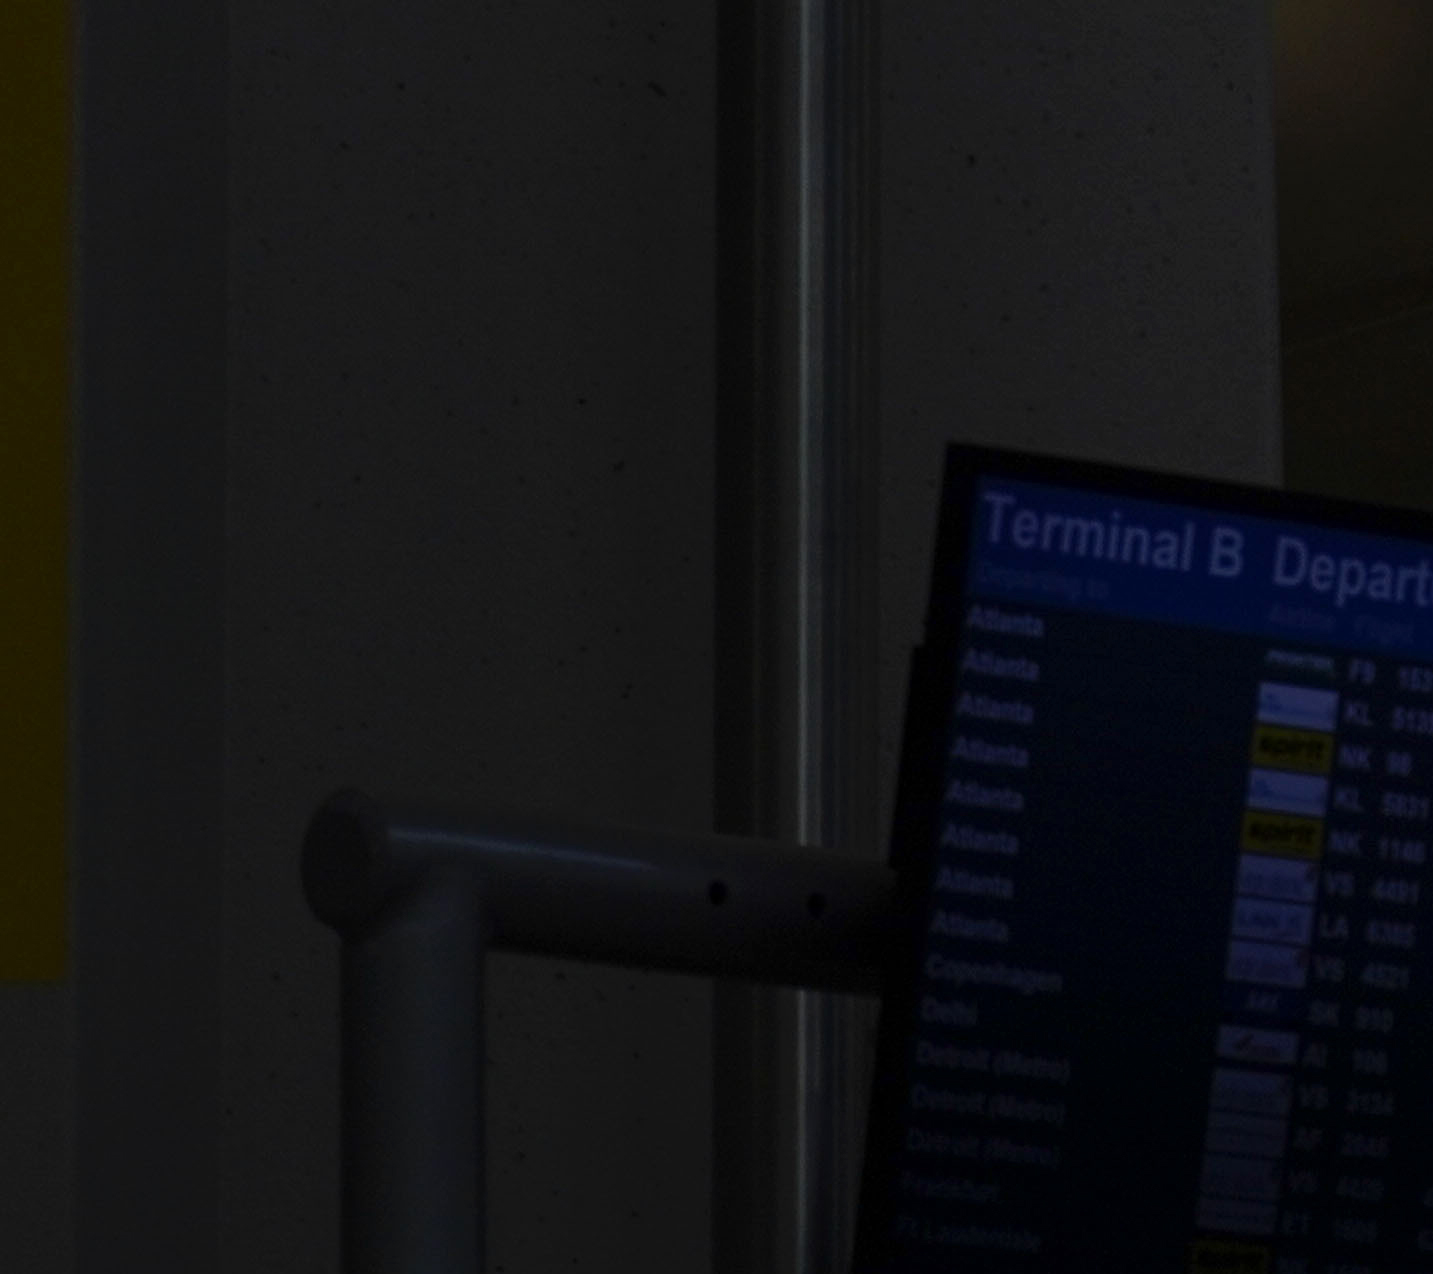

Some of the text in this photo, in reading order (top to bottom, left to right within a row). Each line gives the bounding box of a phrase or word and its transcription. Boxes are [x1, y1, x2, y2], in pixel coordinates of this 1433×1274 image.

[979, 491, 1200, 574] Terminal
[1208, 527, 1247, 579] B
[967, 604, 1046, 641] Atlanta
[962, 648, 1041, 685] Atlanta
[956, 692, 1035, 728] Atlanta
[951, 735, 1030, 771] Atlanta
[946, 779, 1025, 815] Atlanta
[940, 823, 1020, 858] Atlanta
[935, 866, 1014, 902] Atlanta
[929, 910, 1009, 946] Atlanta
